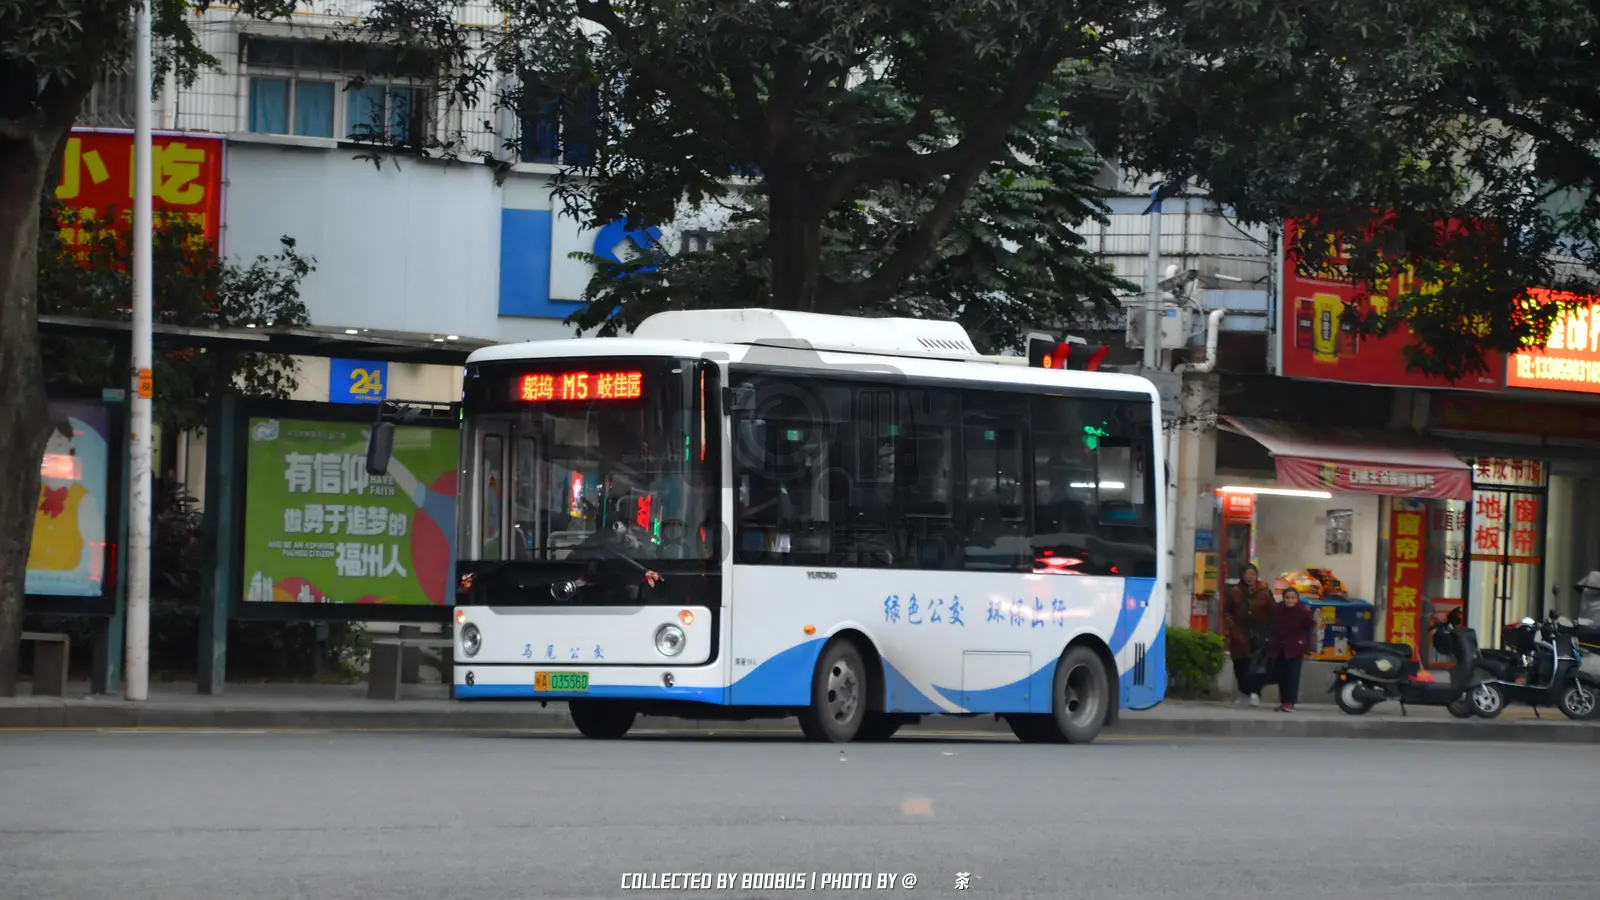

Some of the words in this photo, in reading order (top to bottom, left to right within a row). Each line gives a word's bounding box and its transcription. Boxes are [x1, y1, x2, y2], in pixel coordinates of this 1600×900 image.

[55, 138, 205, 205] 小吃
[349, 368, 382, 395] 24
[562, 374, 589, 400] M5
[285, 452, 368, 495] 有信仰
[370, 486, 395, 496] FAITH
[284, 503, 407, 537] 做勇于追梦的
[1474, 494, 1502, 550] 地板
[1513, 498, 1539, 553] 窗帘
[336, 541, 407, 578] 福州人
[807, 572, 837, 580] YUTONG
[884, 594, 965, 627] 绿色公交
